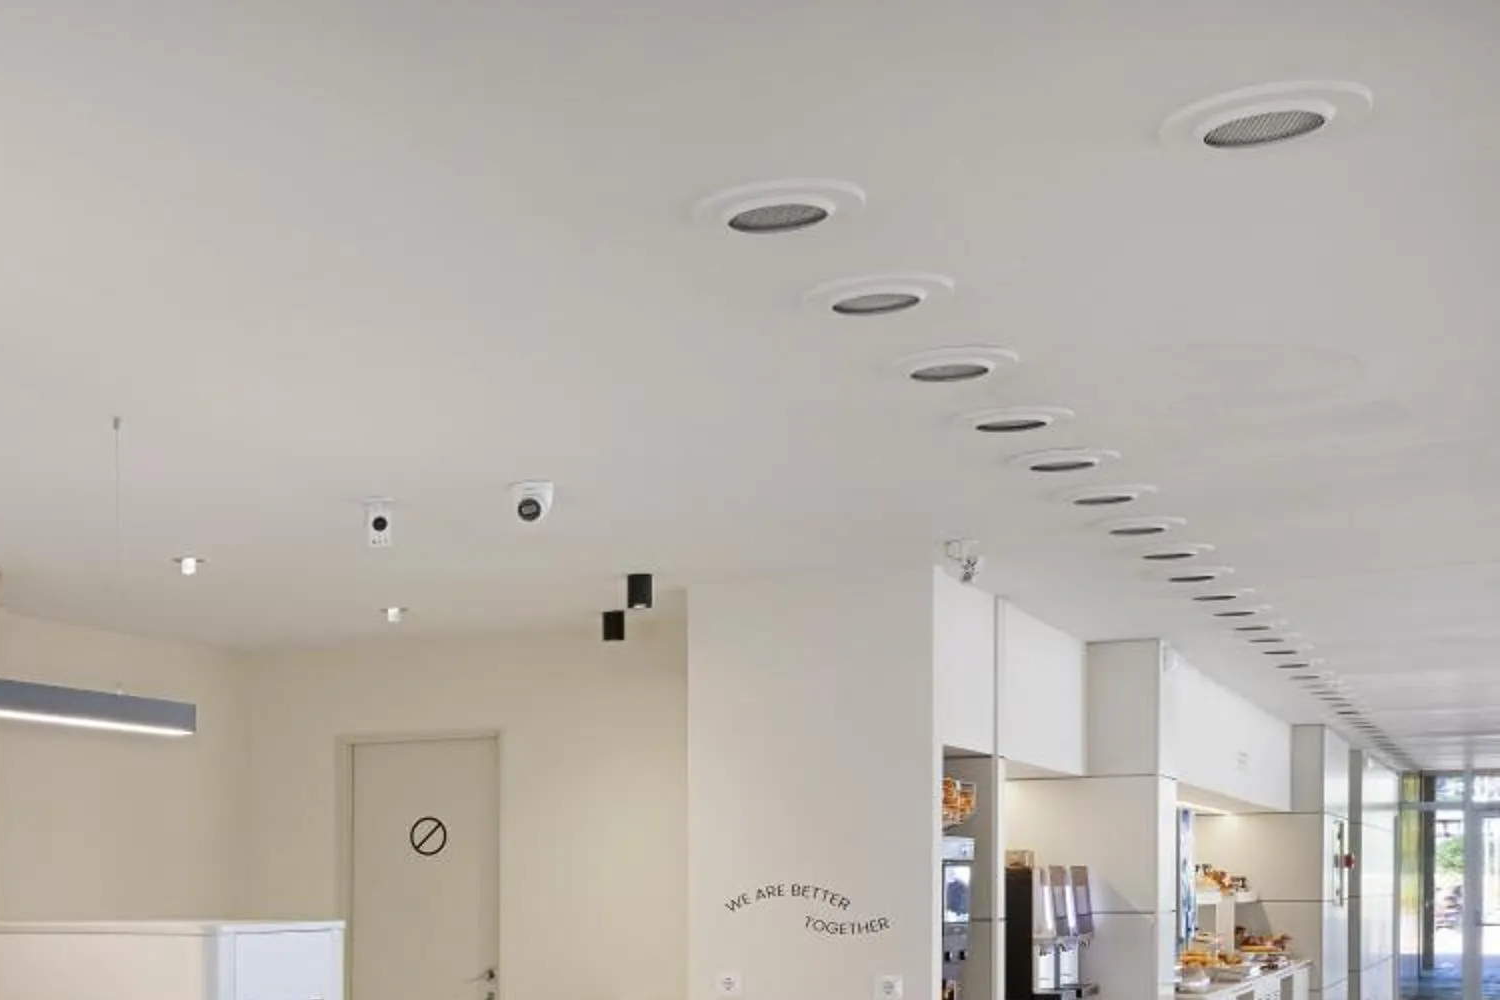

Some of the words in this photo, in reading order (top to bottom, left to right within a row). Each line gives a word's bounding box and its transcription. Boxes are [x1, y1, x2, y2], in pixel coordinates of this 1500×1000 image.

[724, 893, 752, 912] WE
[755, 884, 785, 900] ARE
[791, 883, 851, 910] BETTER
[804, 915, 890, 935] TOGETHER
